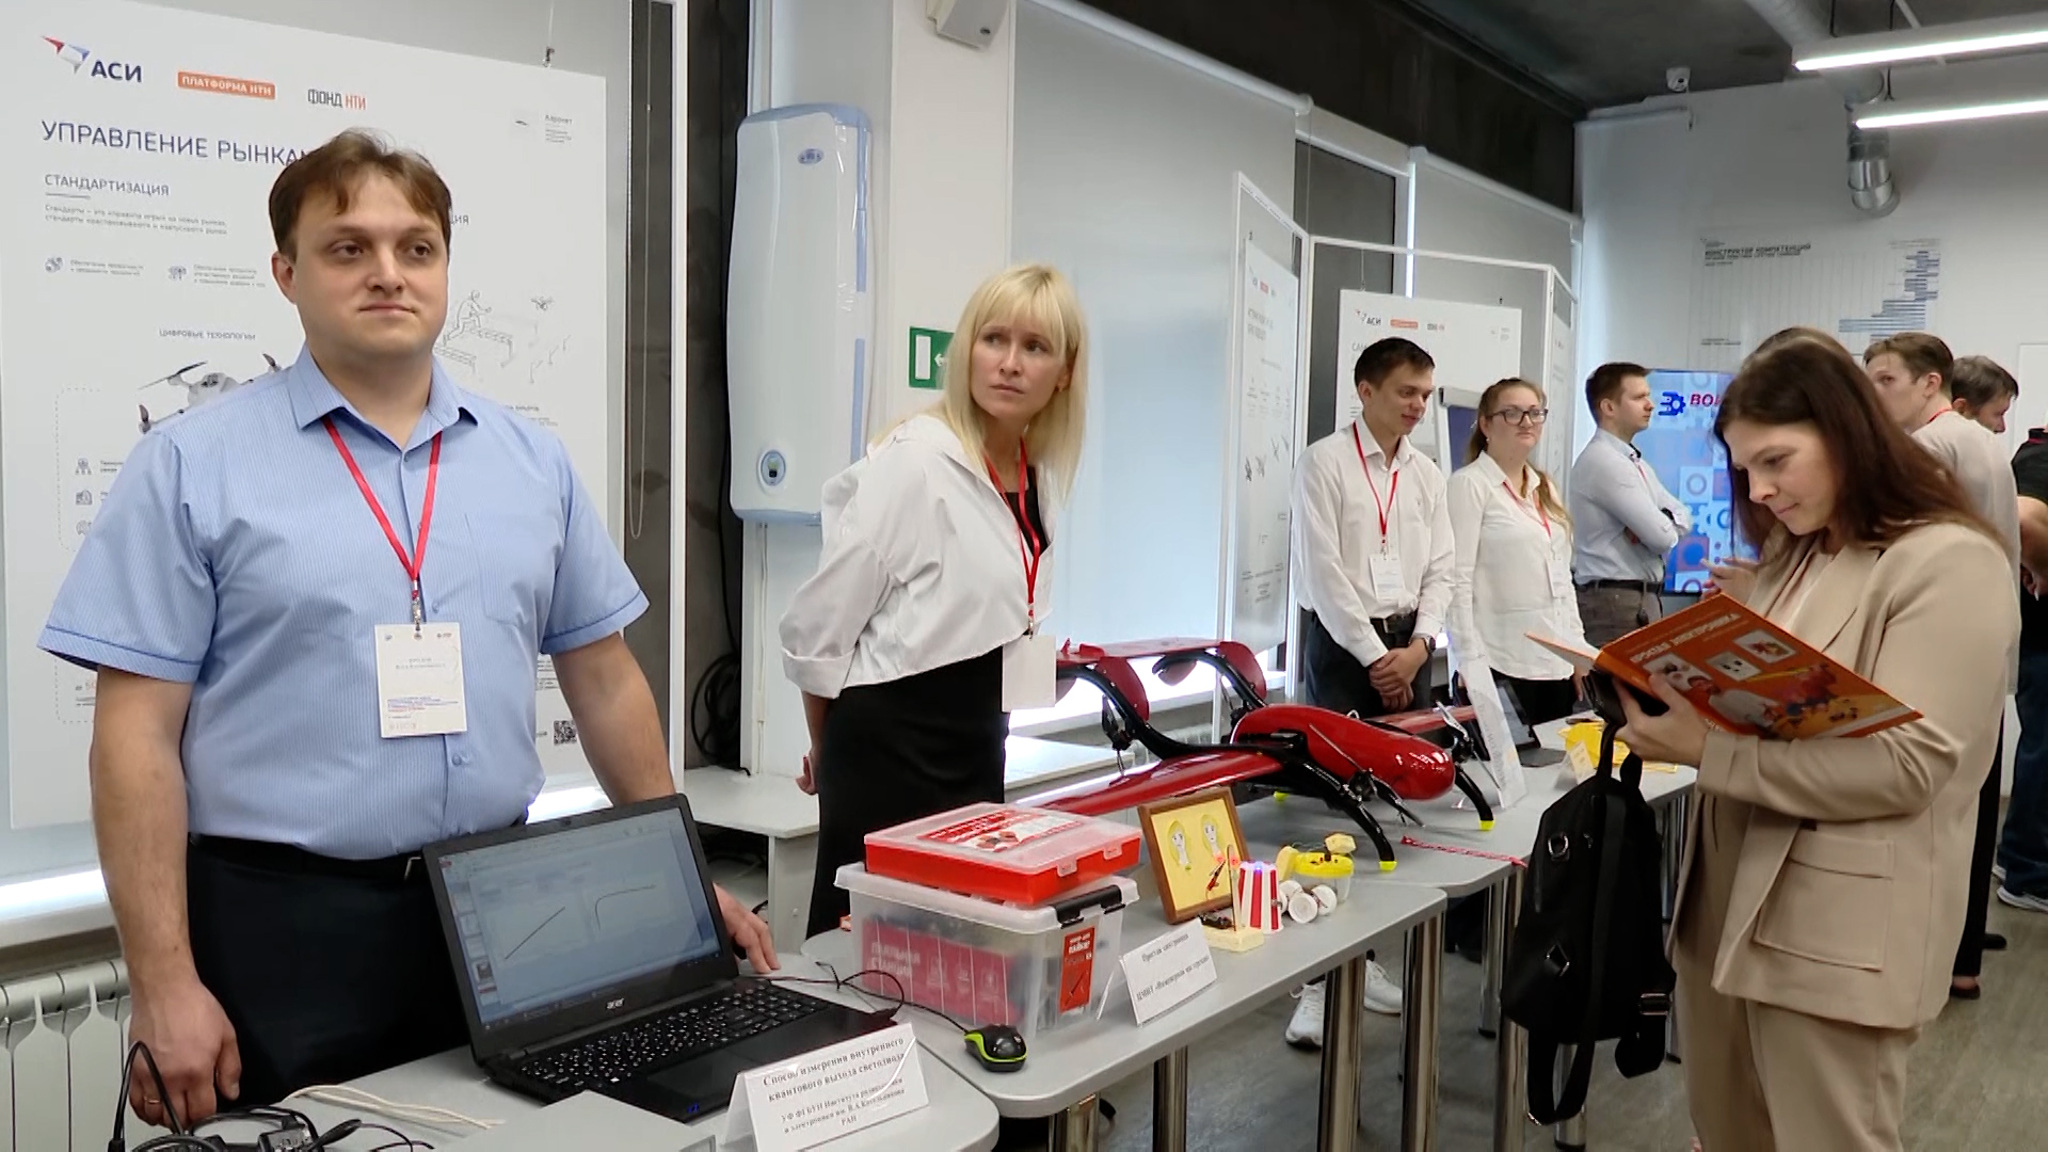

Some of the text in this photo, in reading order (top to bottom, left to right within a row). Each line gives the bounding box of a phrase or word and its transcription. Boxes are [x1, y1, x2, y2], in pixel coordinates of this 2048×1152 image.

[91, 59, 142, 83] АСИ
[182, 76, 272, 97] ПЛАТФОРМА НТИ
[308, 88, 366, 110] ФОНД НТИ
[41, 120, 209, 159] УПРАВЛЕНИЕ
[45, 173, 170, 196] СТАНДАРТИЗАЦИЯ
[1366, 317, 1382, 326] АСИ
[159, 328, 256, 341] ЦИФРОВЫЕ ТЕХНОЛОГИИ
[607, 997, 625, 1009] acer
[763, 1068, 799, 1087] Способ
[850, 1038, 904, 1062] внутреннего
[768, 1079, 823, 1102] квантового
[825, 1068, 858, 1085] выхода
[840, 1114, 857, 1126] РАН
